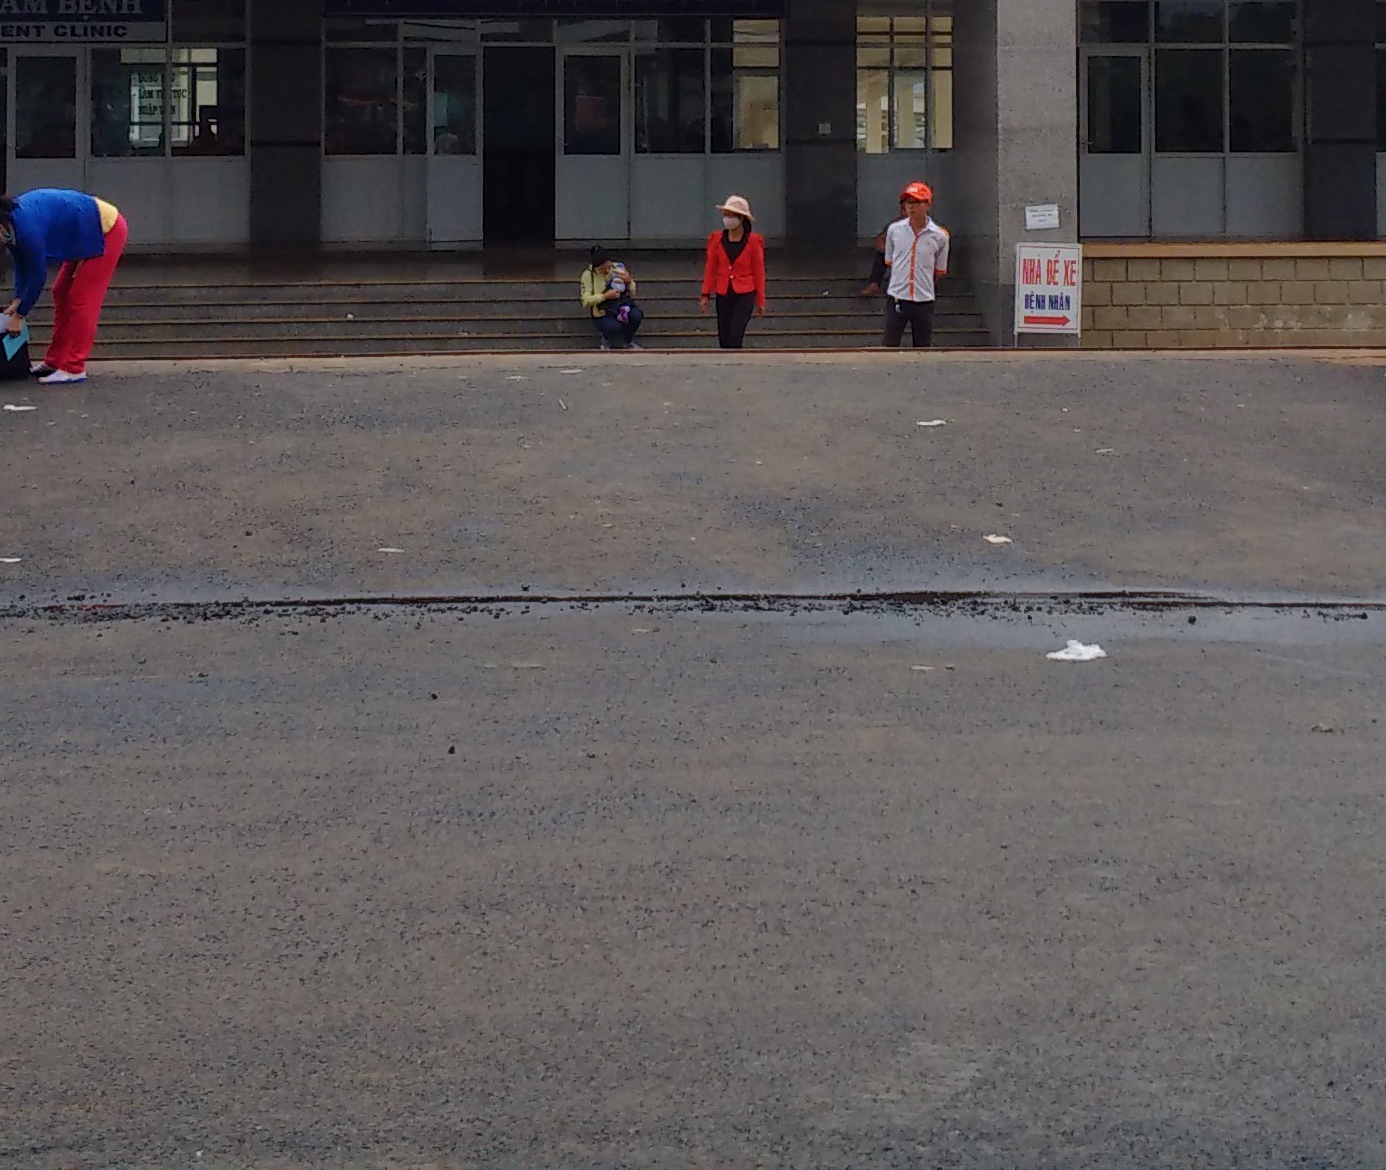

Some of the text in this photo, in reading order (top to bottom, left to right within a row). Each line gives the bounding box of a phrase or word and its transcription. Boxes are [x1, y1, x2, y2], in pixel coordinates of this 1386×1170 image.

[53, 25, 128, 38] CLINIC
[1022, 250, 1077, 287] NHÀ ĐỂ XE
[1024, 291, 1071, 314] BỆNH NHÂN
